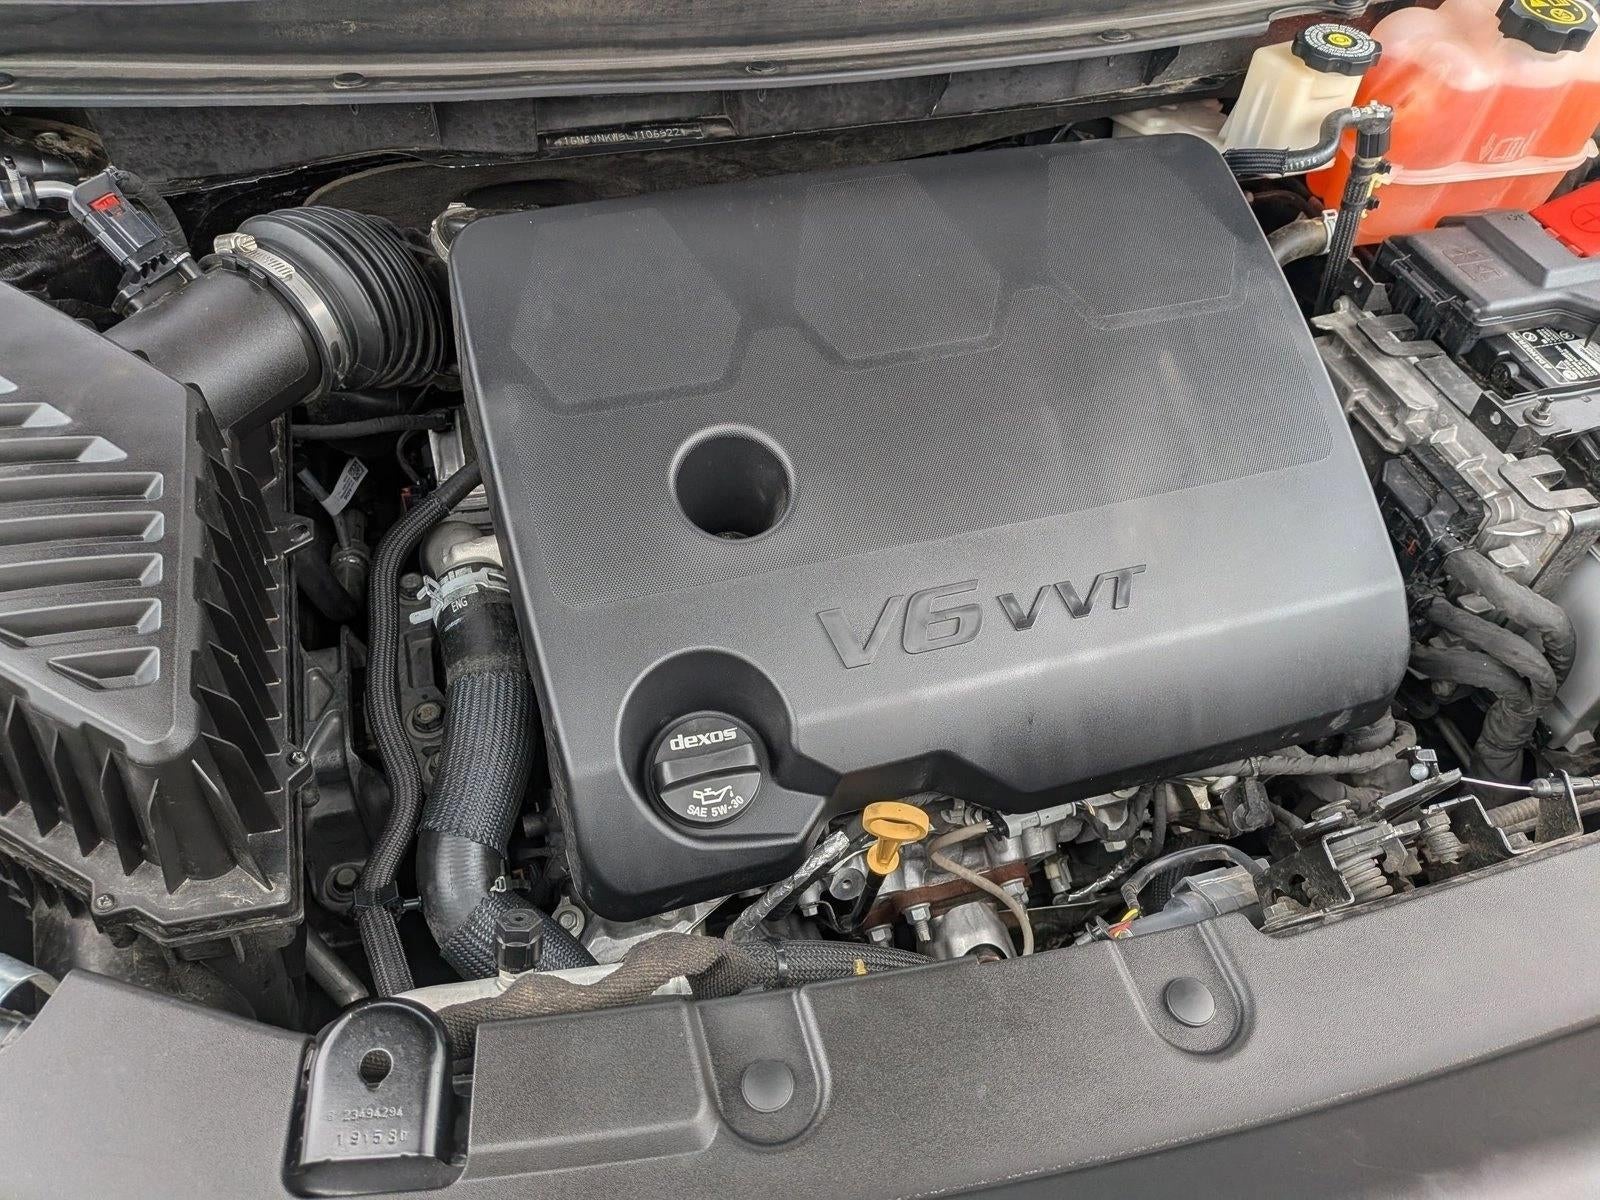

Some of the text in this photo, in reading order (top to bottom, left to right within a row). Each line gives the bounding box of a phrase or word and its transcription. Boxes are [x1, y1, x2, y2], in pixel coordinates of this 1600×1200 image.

[451, 596, 468, 613] ENG
[816, 563, 1147, 669] V6 VVT
[669, 727, 738, 751] dexos
[686, 795, 744, 817] SAE 5W-30
